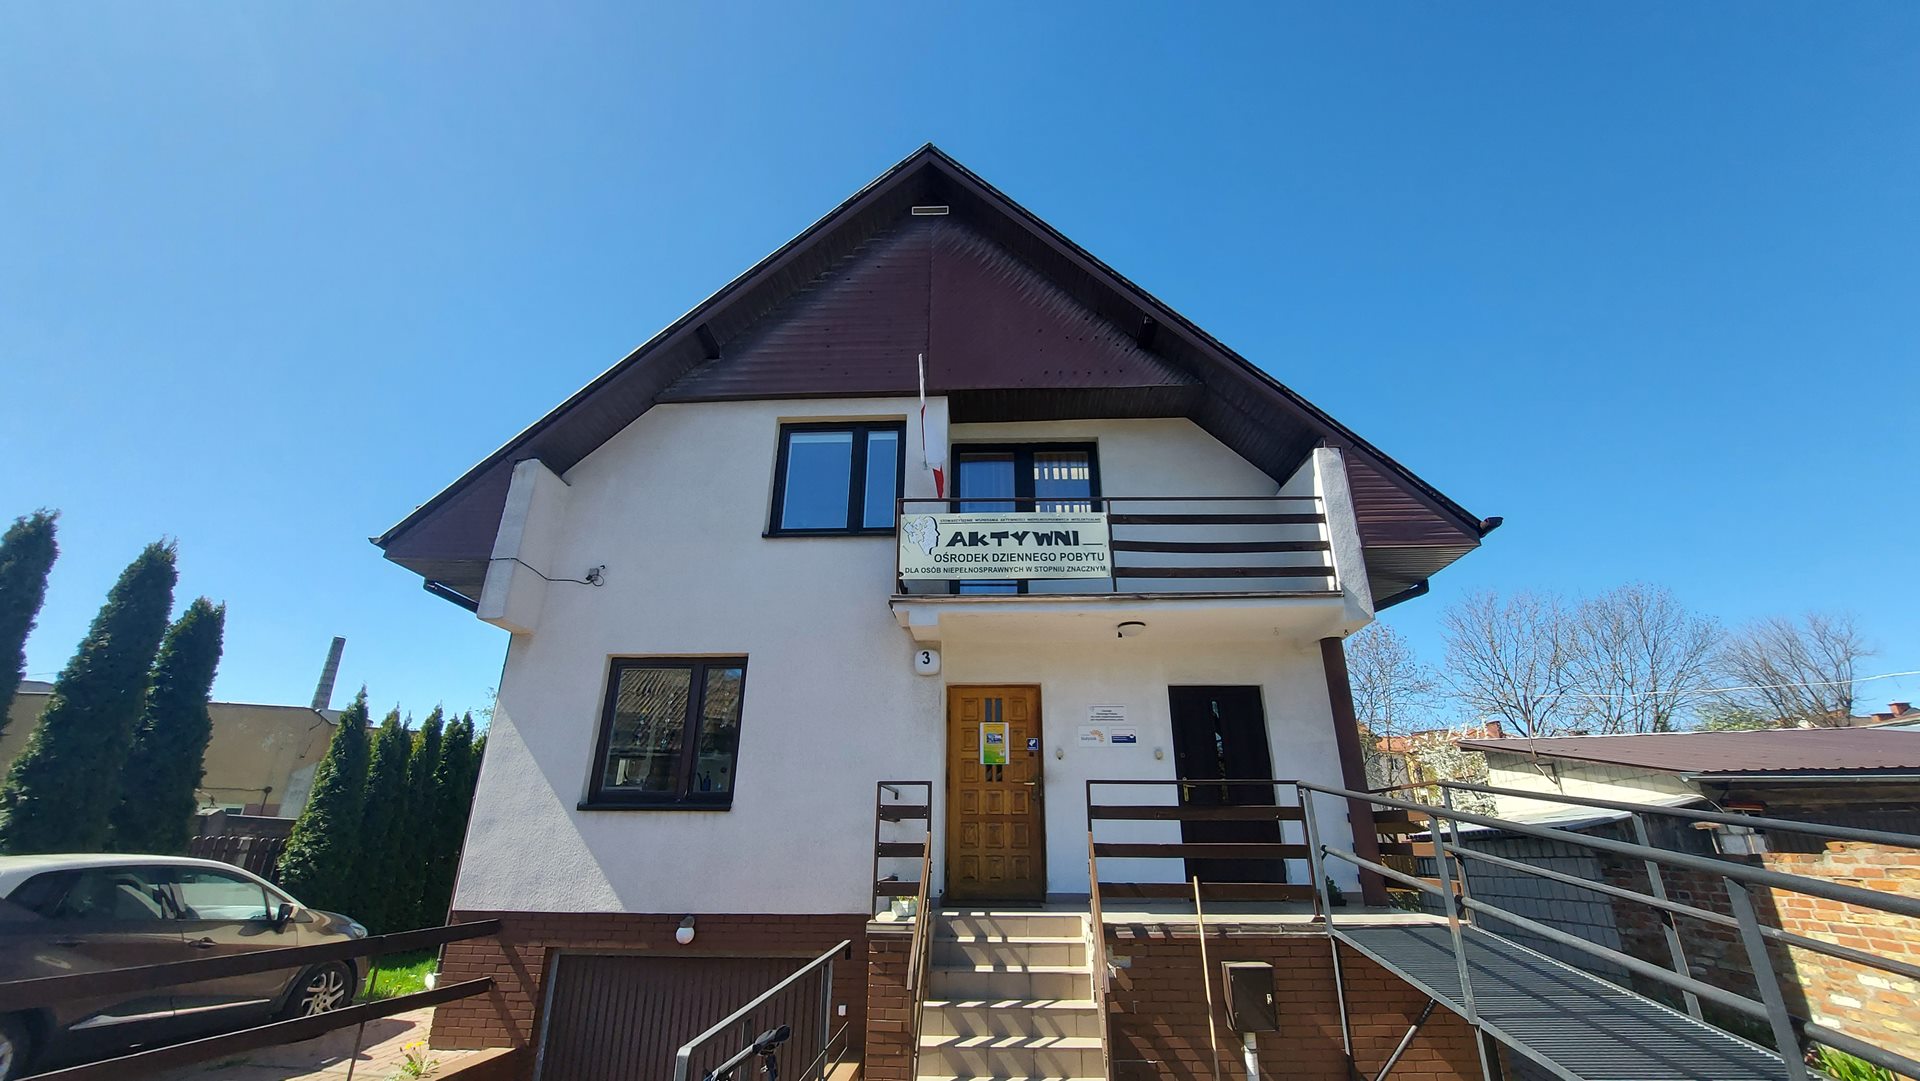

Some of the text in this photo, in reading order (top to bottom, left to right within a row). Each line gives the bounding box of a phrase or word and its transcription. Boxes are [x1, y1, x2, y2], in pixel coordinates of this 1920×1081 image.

[934, 552, 1105, 562] OŚRODEK DZIENNEGO POBYTU
[922, 651, 930, 664] 3
